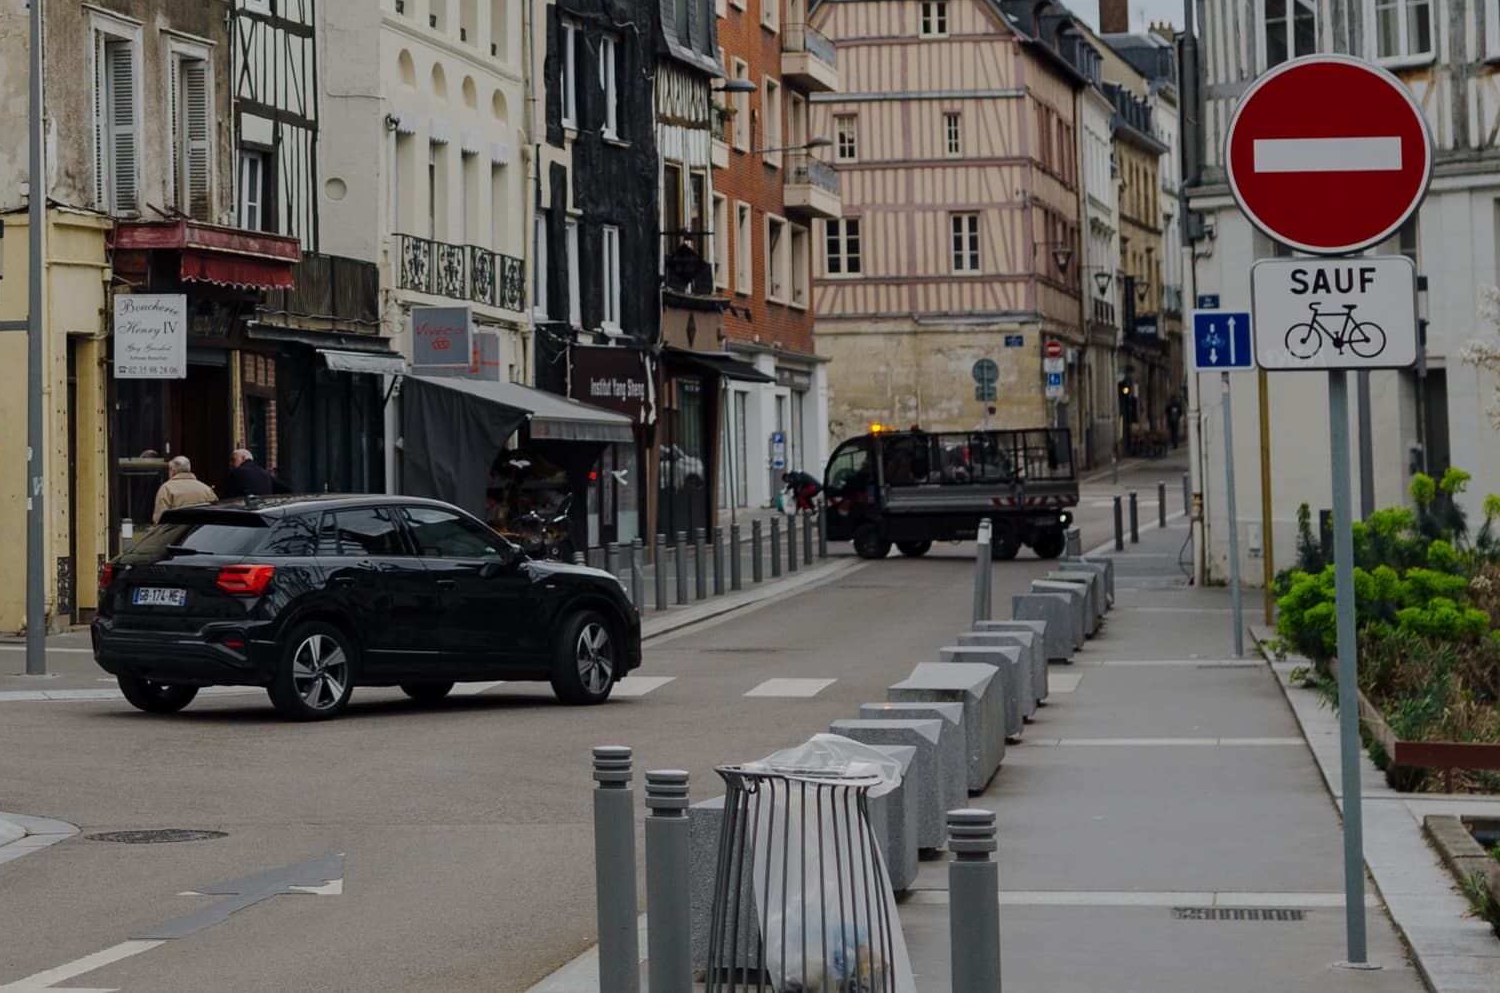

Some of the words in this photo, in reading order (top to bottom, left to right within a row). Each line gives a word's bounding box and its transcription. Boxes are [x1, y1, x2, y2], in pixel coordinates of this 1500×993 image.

[1290, 267, 1376, 295] SAUF
[119, 298, 180, 316] Boucherie
[117, 320, 160, 340] Henry
[163, 320, 178, 334] IV
[590, 377, 612, 396] Institut
[612, 377, 626, 402] Yang
[627, 377, 644, 402] Sheng
